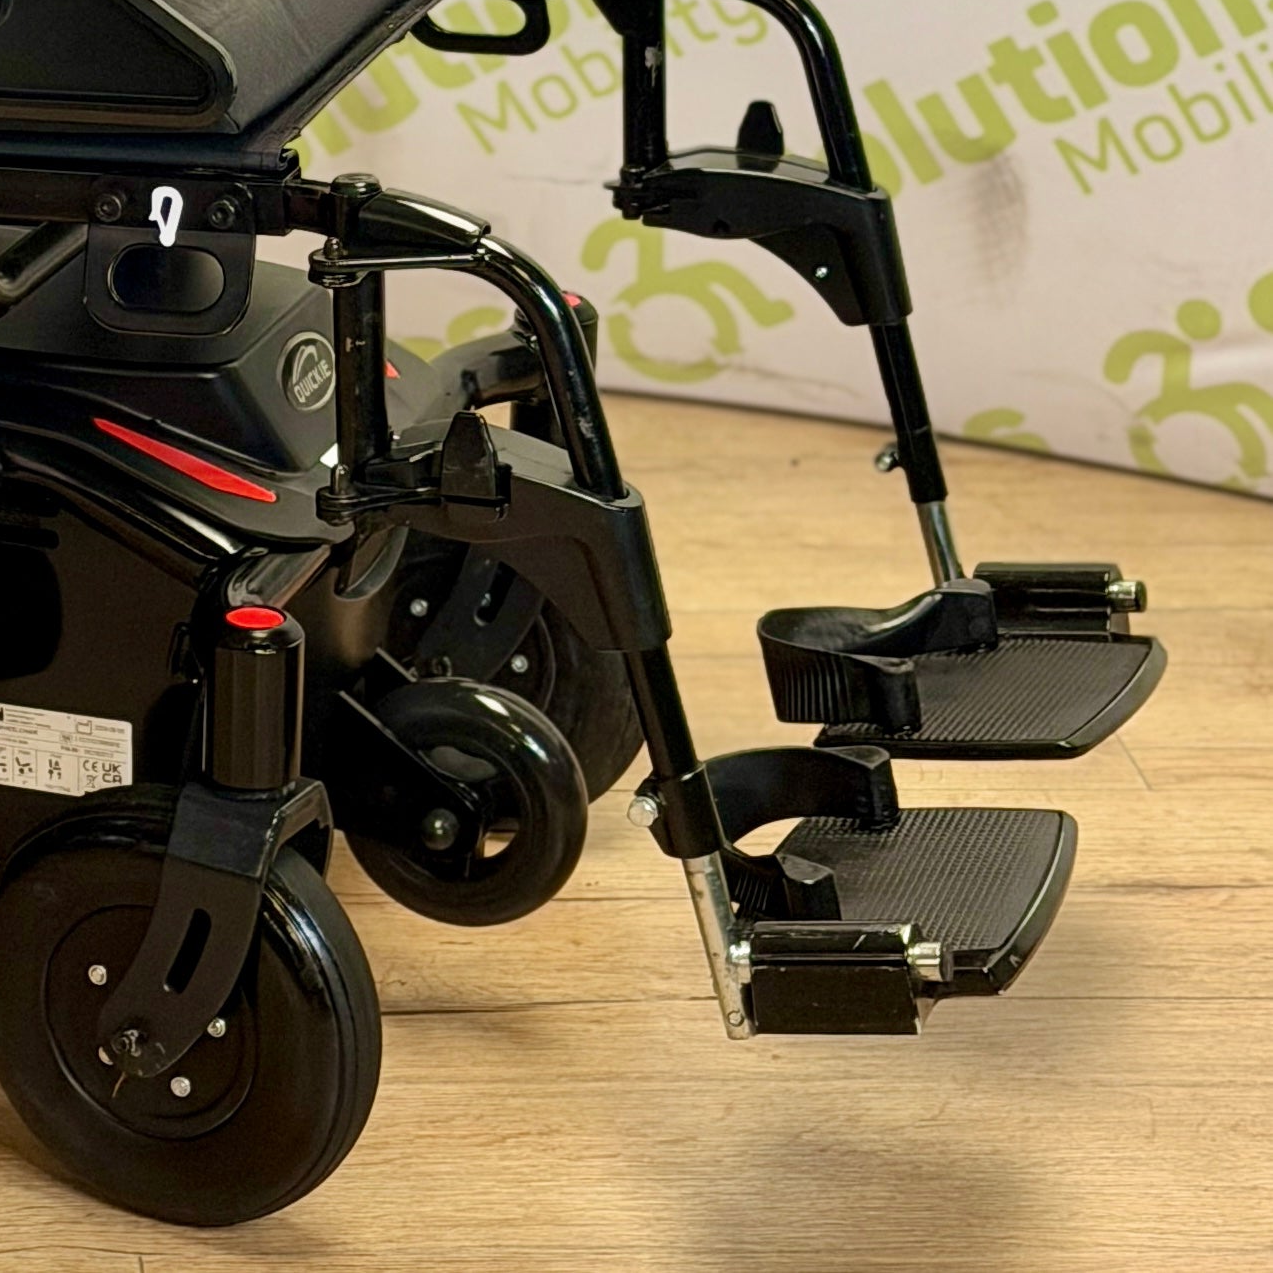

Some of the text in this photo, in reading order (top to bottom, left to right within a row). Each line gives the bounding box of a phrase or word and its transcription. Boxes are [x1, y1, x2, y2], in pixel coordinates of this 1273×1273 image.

[293, 359, 332, 403] QUICKIE
[83, 759, 98, 773] CE
[102, 762, 122, 774] UK
